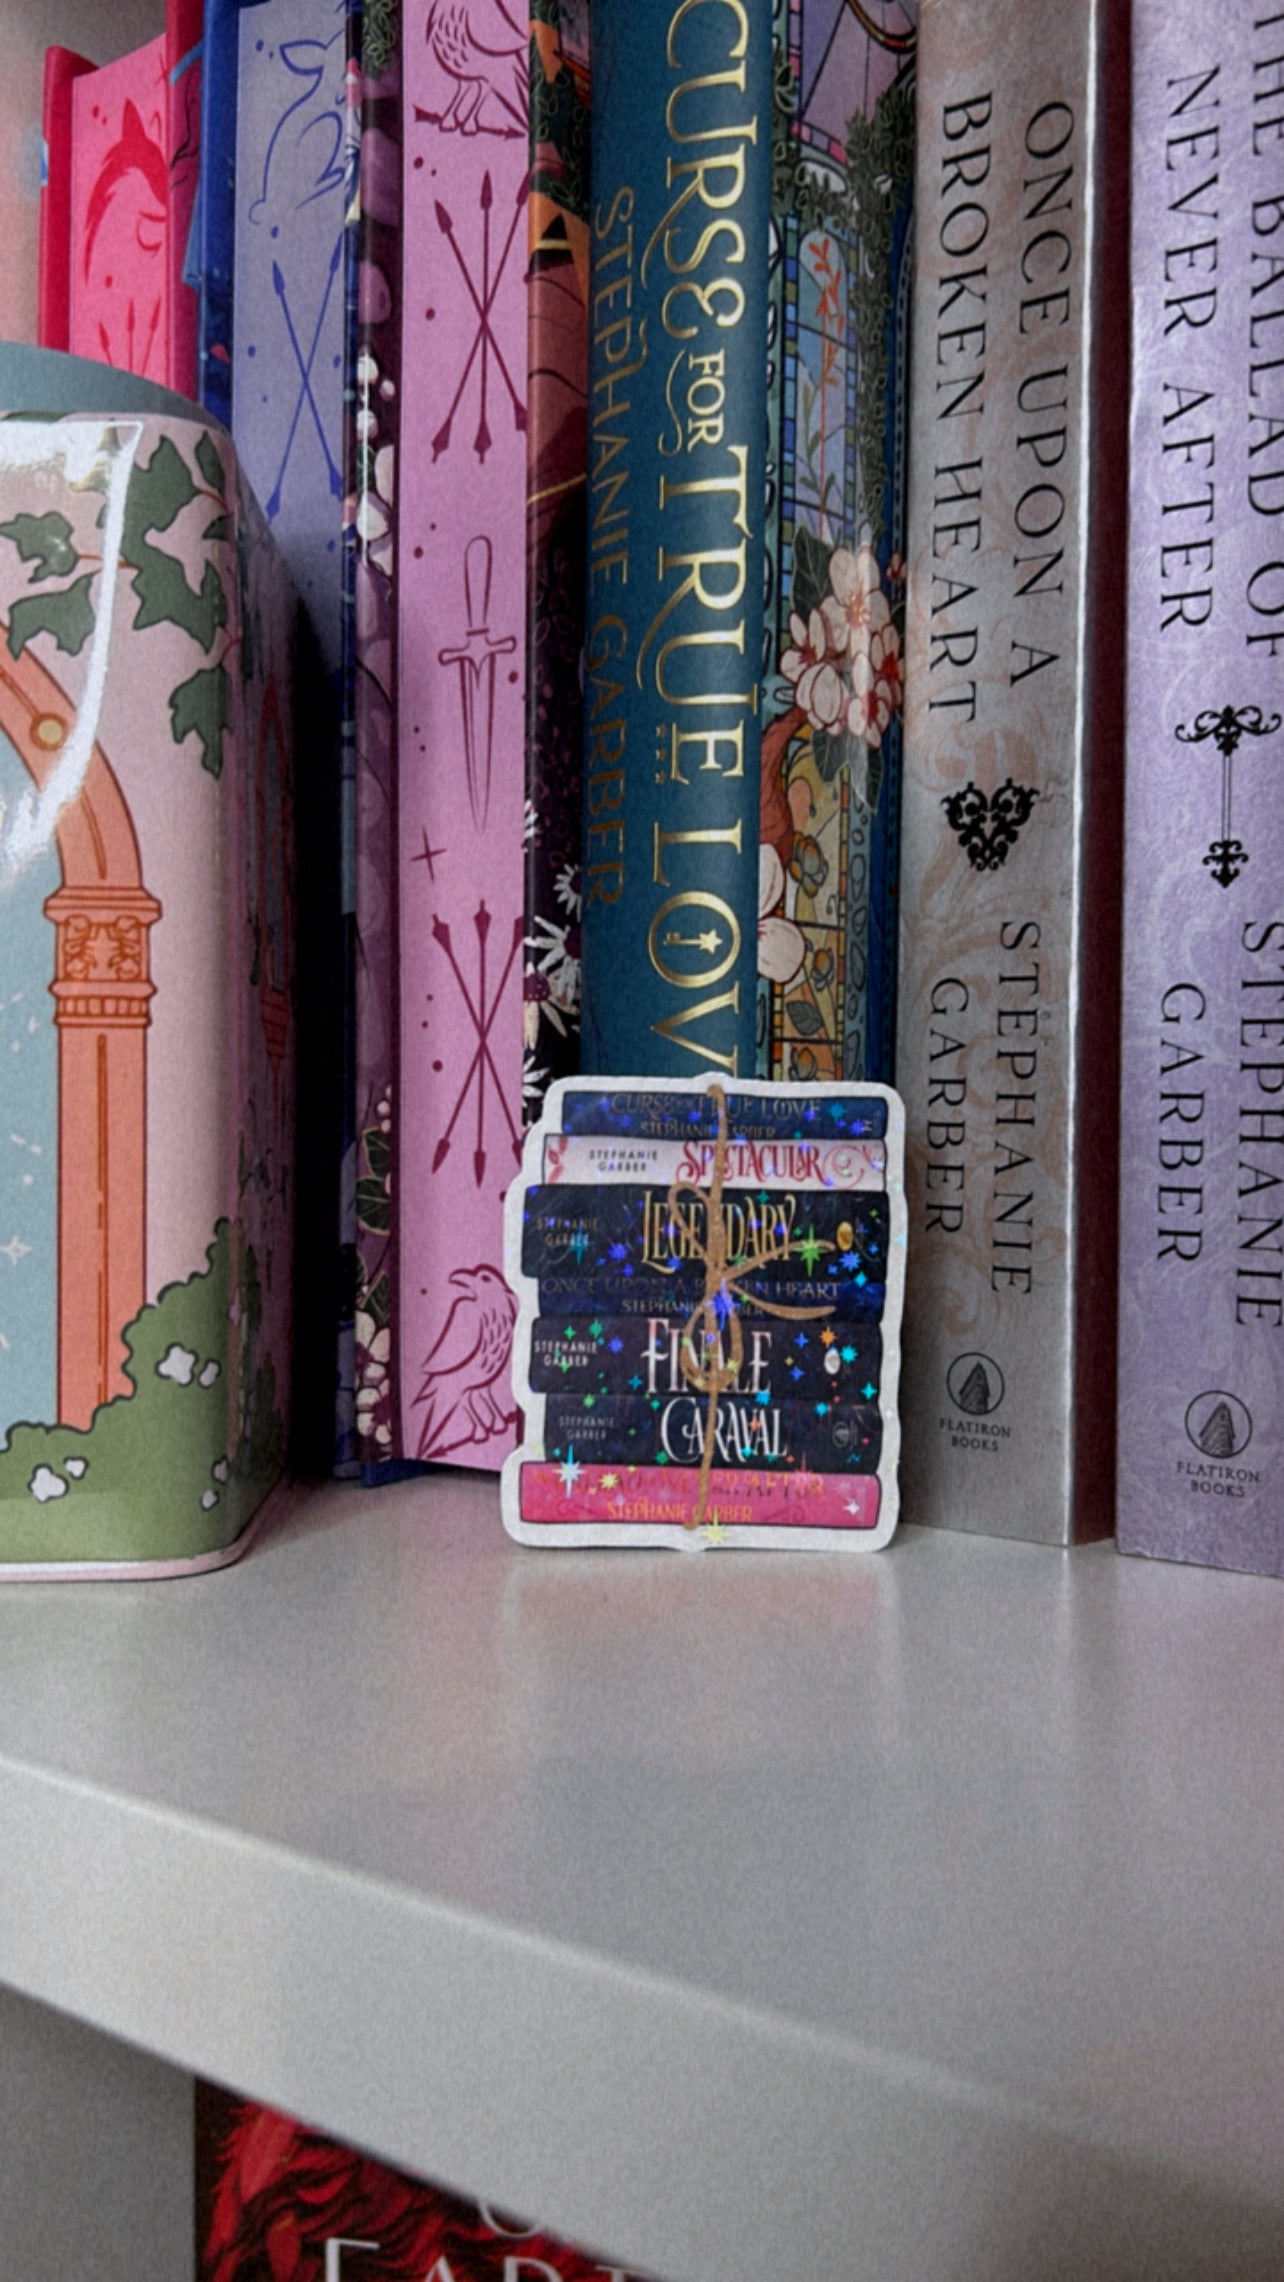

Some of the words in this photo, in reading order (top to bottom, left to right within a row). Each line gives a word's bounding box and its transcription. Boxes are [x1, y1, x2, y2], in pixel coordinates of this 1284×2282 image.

[1018, 102, 1076, 333] ONCE
[1163, 65, 1220, 336] NEVER
[936, 93, 993, 421] BROKEN
[591, 185, 648, 584] STEPHANIE
[687, 349, 725, 452] FOR
[1248, 195, 1284, 516] BALLAD
[1013, 365, 1067, 598] UPON
[1159, 384, 1215, 632] AFTER
[636, 445, 757, 786] TRUE
[928, 459, 983, 722] HEART
[1010, 640, 1060, 686] A
[584, 613, 629, 907] GARBER
[648, 820, 741, 1077] LOV
[641, 1119, 716, 1138] STEPHANI
[725, 1124, 777, 1138] ARBER
[925, 978, 970, 1234] GARBER
[991, 921, 1042, 1294] STEPHANIE
[1157, 983, 1206, 1262] GARBER
[1236, 921, 1284, 1327] STEPHANIE
[589, 1149, 659, 1161] STEPHANIE
[597, 1162, 647, 1173] GARBER
[676, 1139, 832, 1187] SPCTACULAR
[642, 1191, 797, 1275] LEGEDARY
[777, 1283, 841, 1299] HEART
[534, 1340, 598, 1354] STEPHANIE
[543, 1354, 589, 1368] GARBER
[559, 1416, 615, 1428] STEPHANIE
[660, 1396, 788, 1464] CARAVAL
[939, 1418, 1011, 1438] FLATIRON
[951, 1435, 999, 1452] BOOKS
[607, 1498, 687, 1520] STEPHANIE
[1176, 1461, 1260, 1484] FLATIRON
[1190, 1479, 1245, 1498] BOOKS
